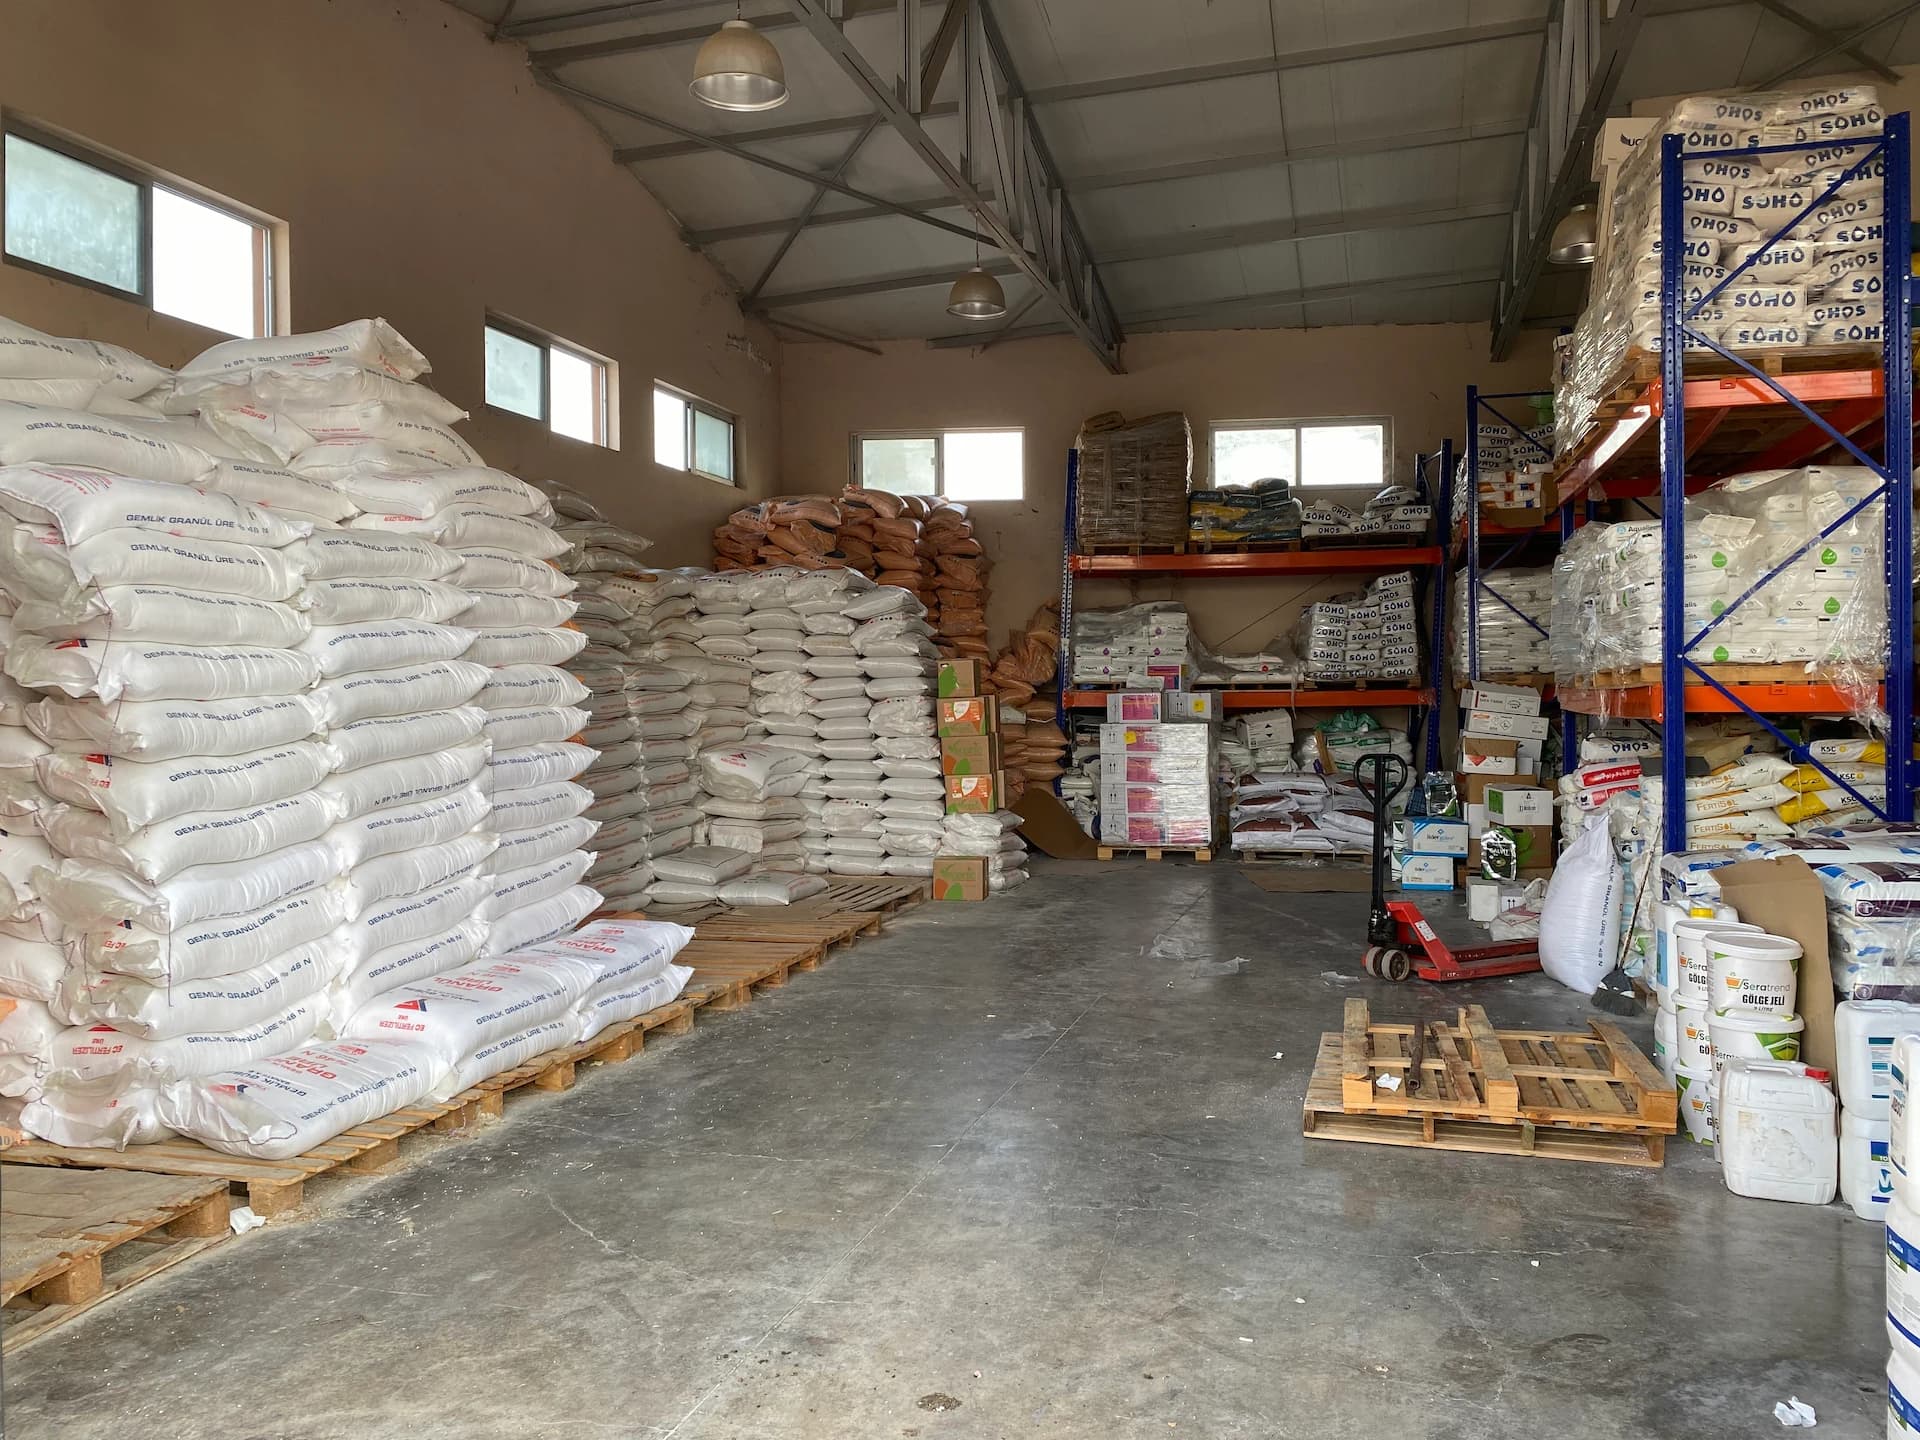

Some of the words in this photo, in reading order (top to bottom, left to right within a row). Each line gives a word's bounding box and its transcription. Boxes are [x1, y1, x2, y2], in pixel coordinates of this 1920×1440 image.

[1821, 109, 1881, 134] SOHO
[1683, 185, 1725, 202] OHO
[1742, 192, 1803, 209] SOHO
[1837, 225, 1882, 241] SOH
[1735, 290, 1796, 307] SOHO
[1739, 327, 1798, 343] SOHO
[1834, 325, 1880, 341] SOH
[169, 517, 212, 526] GRANÜL
[215, 518, 234, 528] ÜRE
[1382, 575, 1408, 586] SOHO
[1319, 605, 1344, 614] SOHO
[1384, 601, 1410, 611] SOHO
[1351, 611, 1377, 619] SOHO
[1386, 623, 1412, 632] SOHO
[1352, 632, 1378, 640] SOHO
[1313, 651, 1339, 659] SOHO
[1387, 646, 1414, 655] SOHO
[1689, 973, 1706, 985] GÖLG
[1743, 982, 1791, 993] Seratrend
[1743, 994, 1769, 1005] GÖLGE
